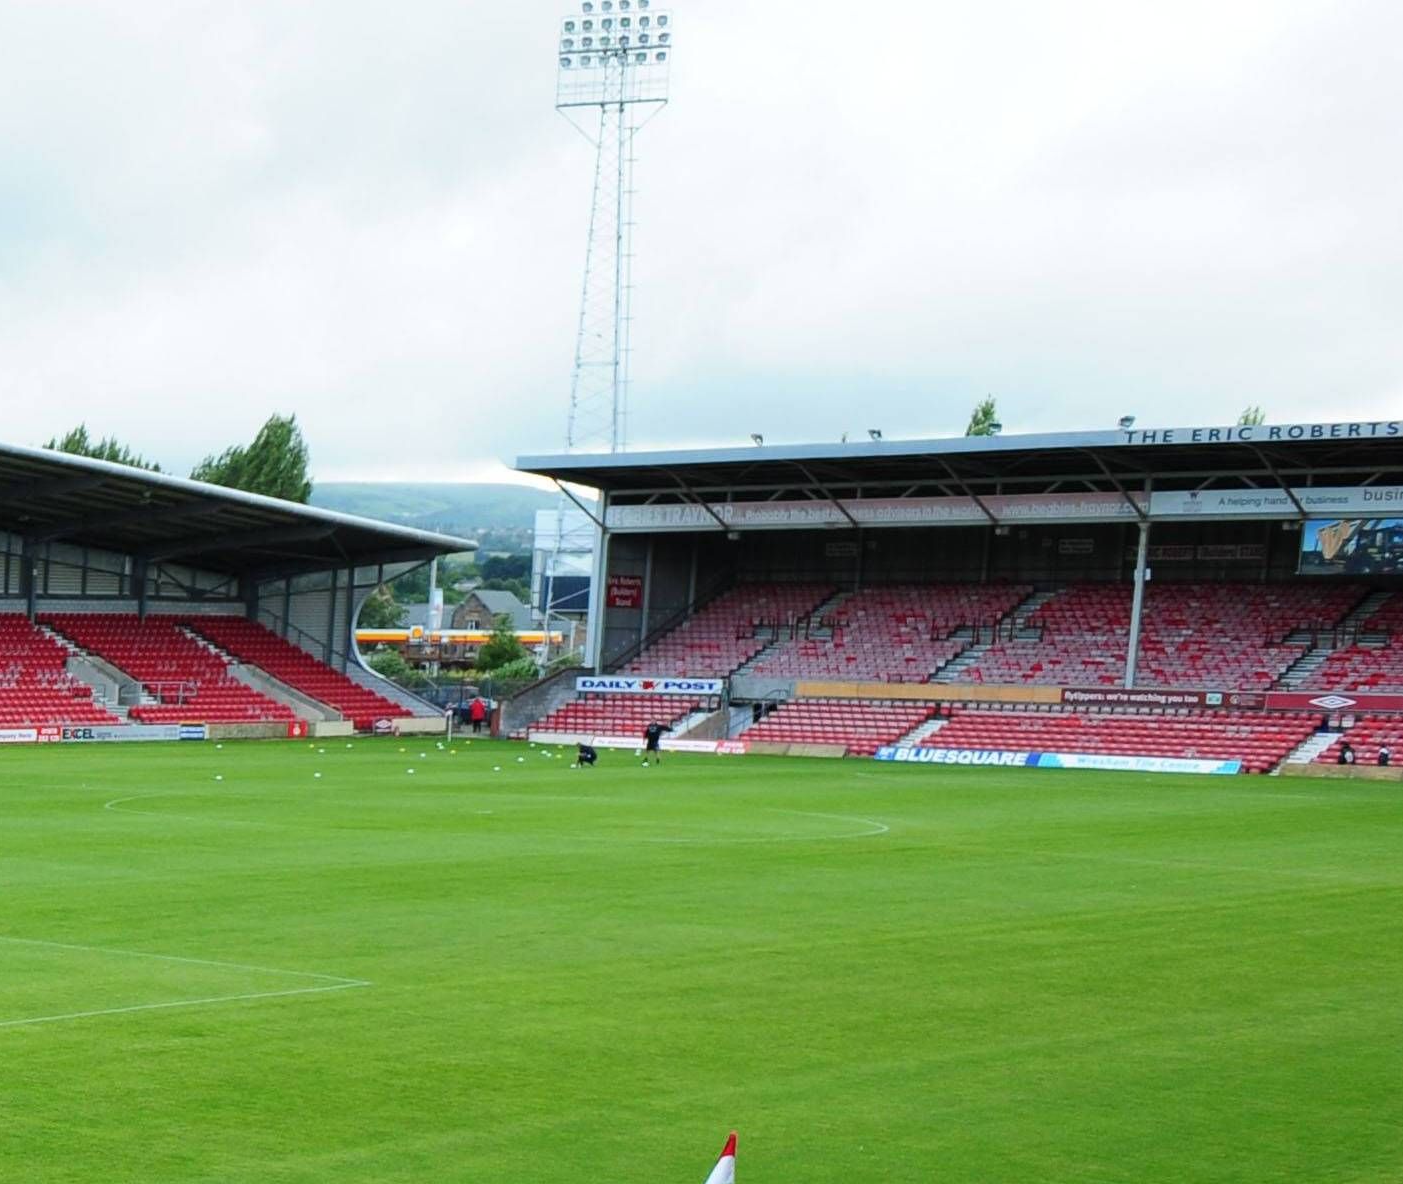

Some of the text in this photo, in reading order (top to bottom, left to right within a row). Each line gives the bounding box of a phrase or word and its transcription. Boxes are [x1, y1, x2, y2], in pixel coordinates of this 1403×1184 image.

[1125, 421, 1400, 444] THE ERIC ROBERTS
[581, 680, 717, 690] DAILY POST
[62, 728, 95, 740] EXCEL
[894, 748, 1027, 766] BLUESQUARE
